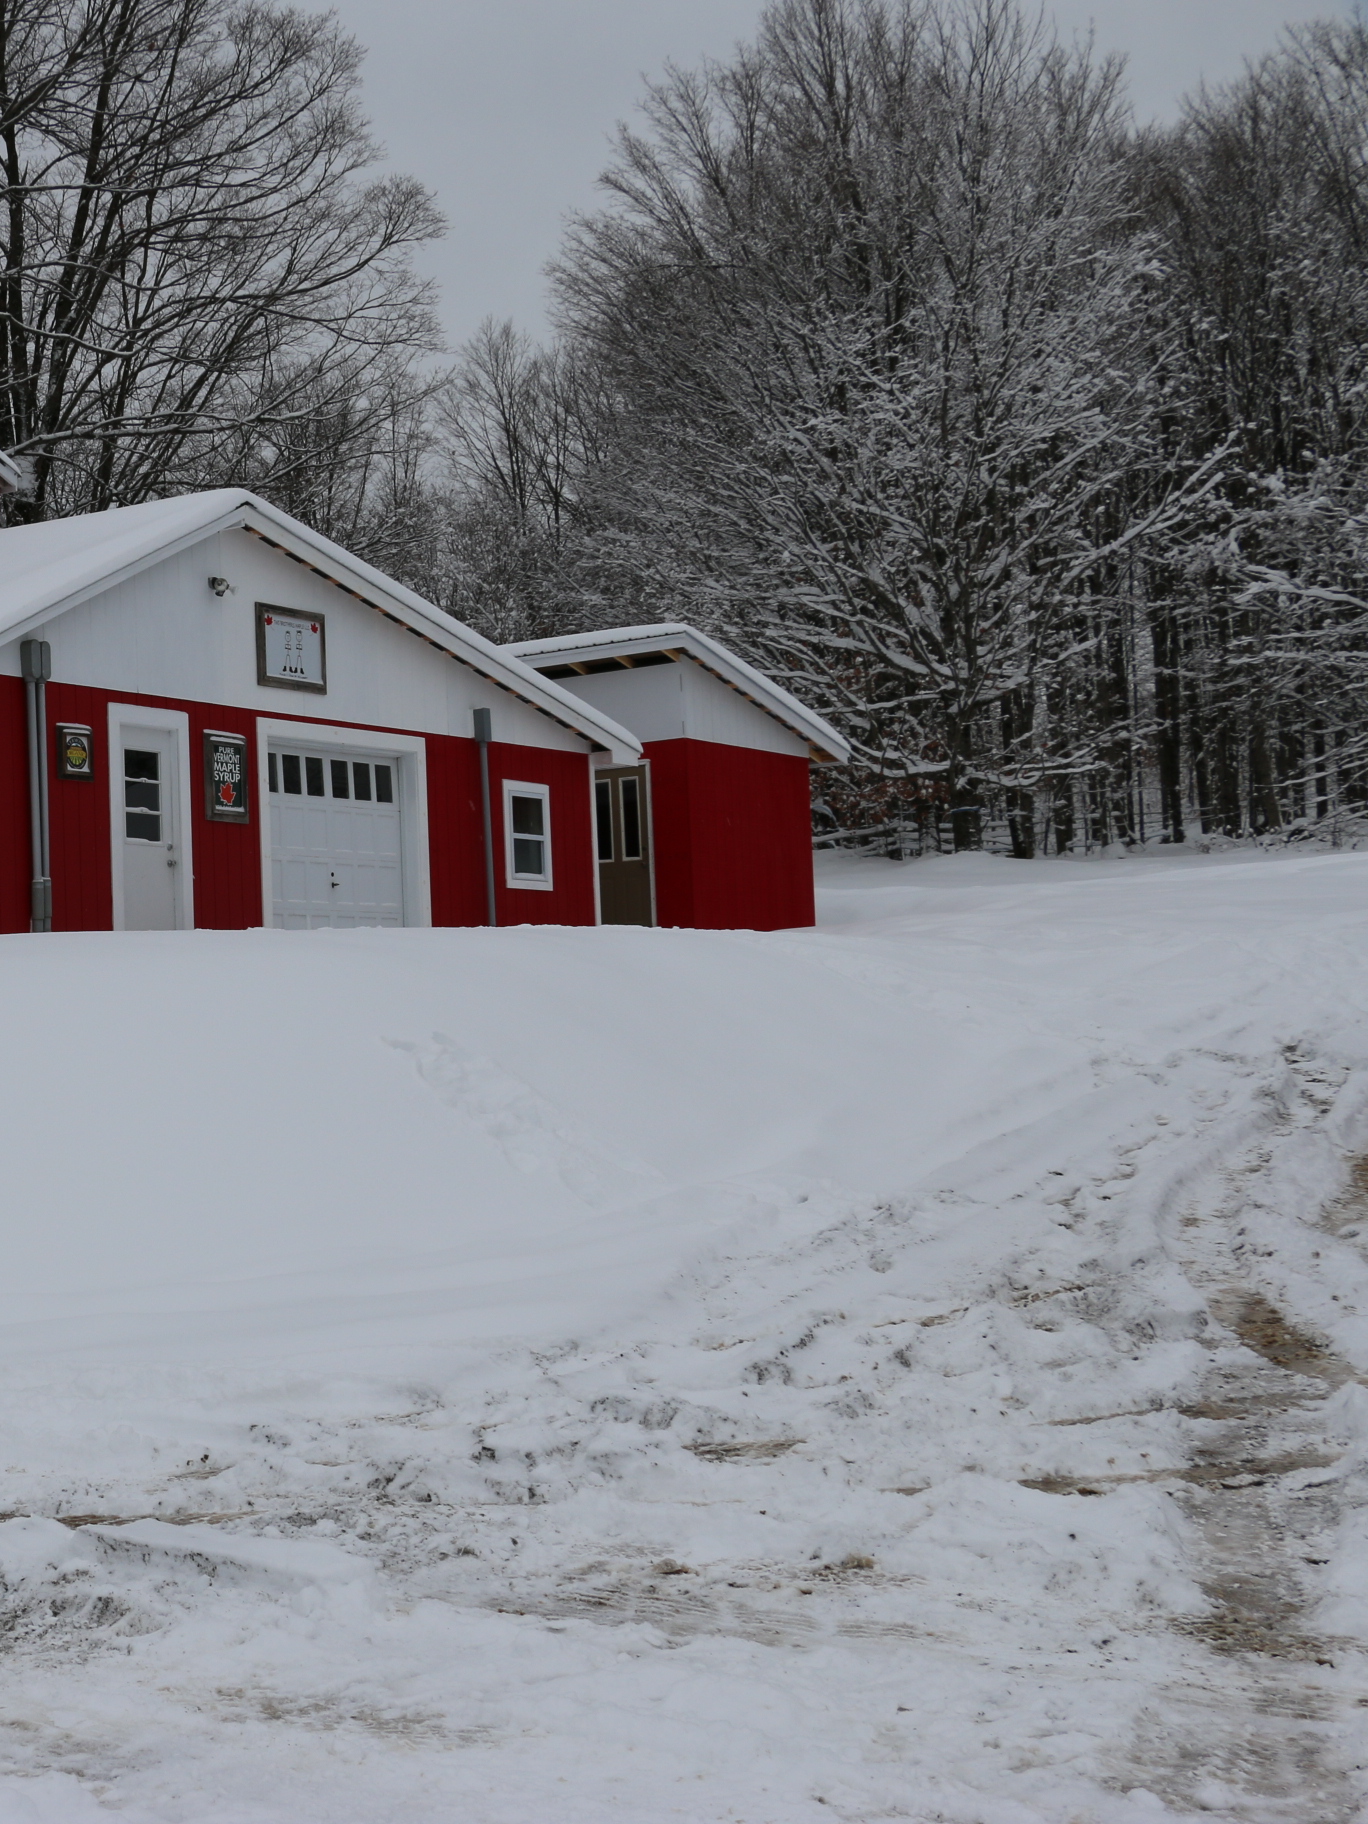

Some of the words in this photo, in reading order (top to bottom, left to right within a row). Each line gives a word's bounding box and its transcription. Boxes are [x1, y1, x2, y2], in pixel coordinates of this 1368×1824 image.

[218, 746, 235, 755] PURE
[213, 752, 240, 764] VERMONT
[214, 761, 241, 774] MAPLE
[214, 770, 241, 783] SYRUP
